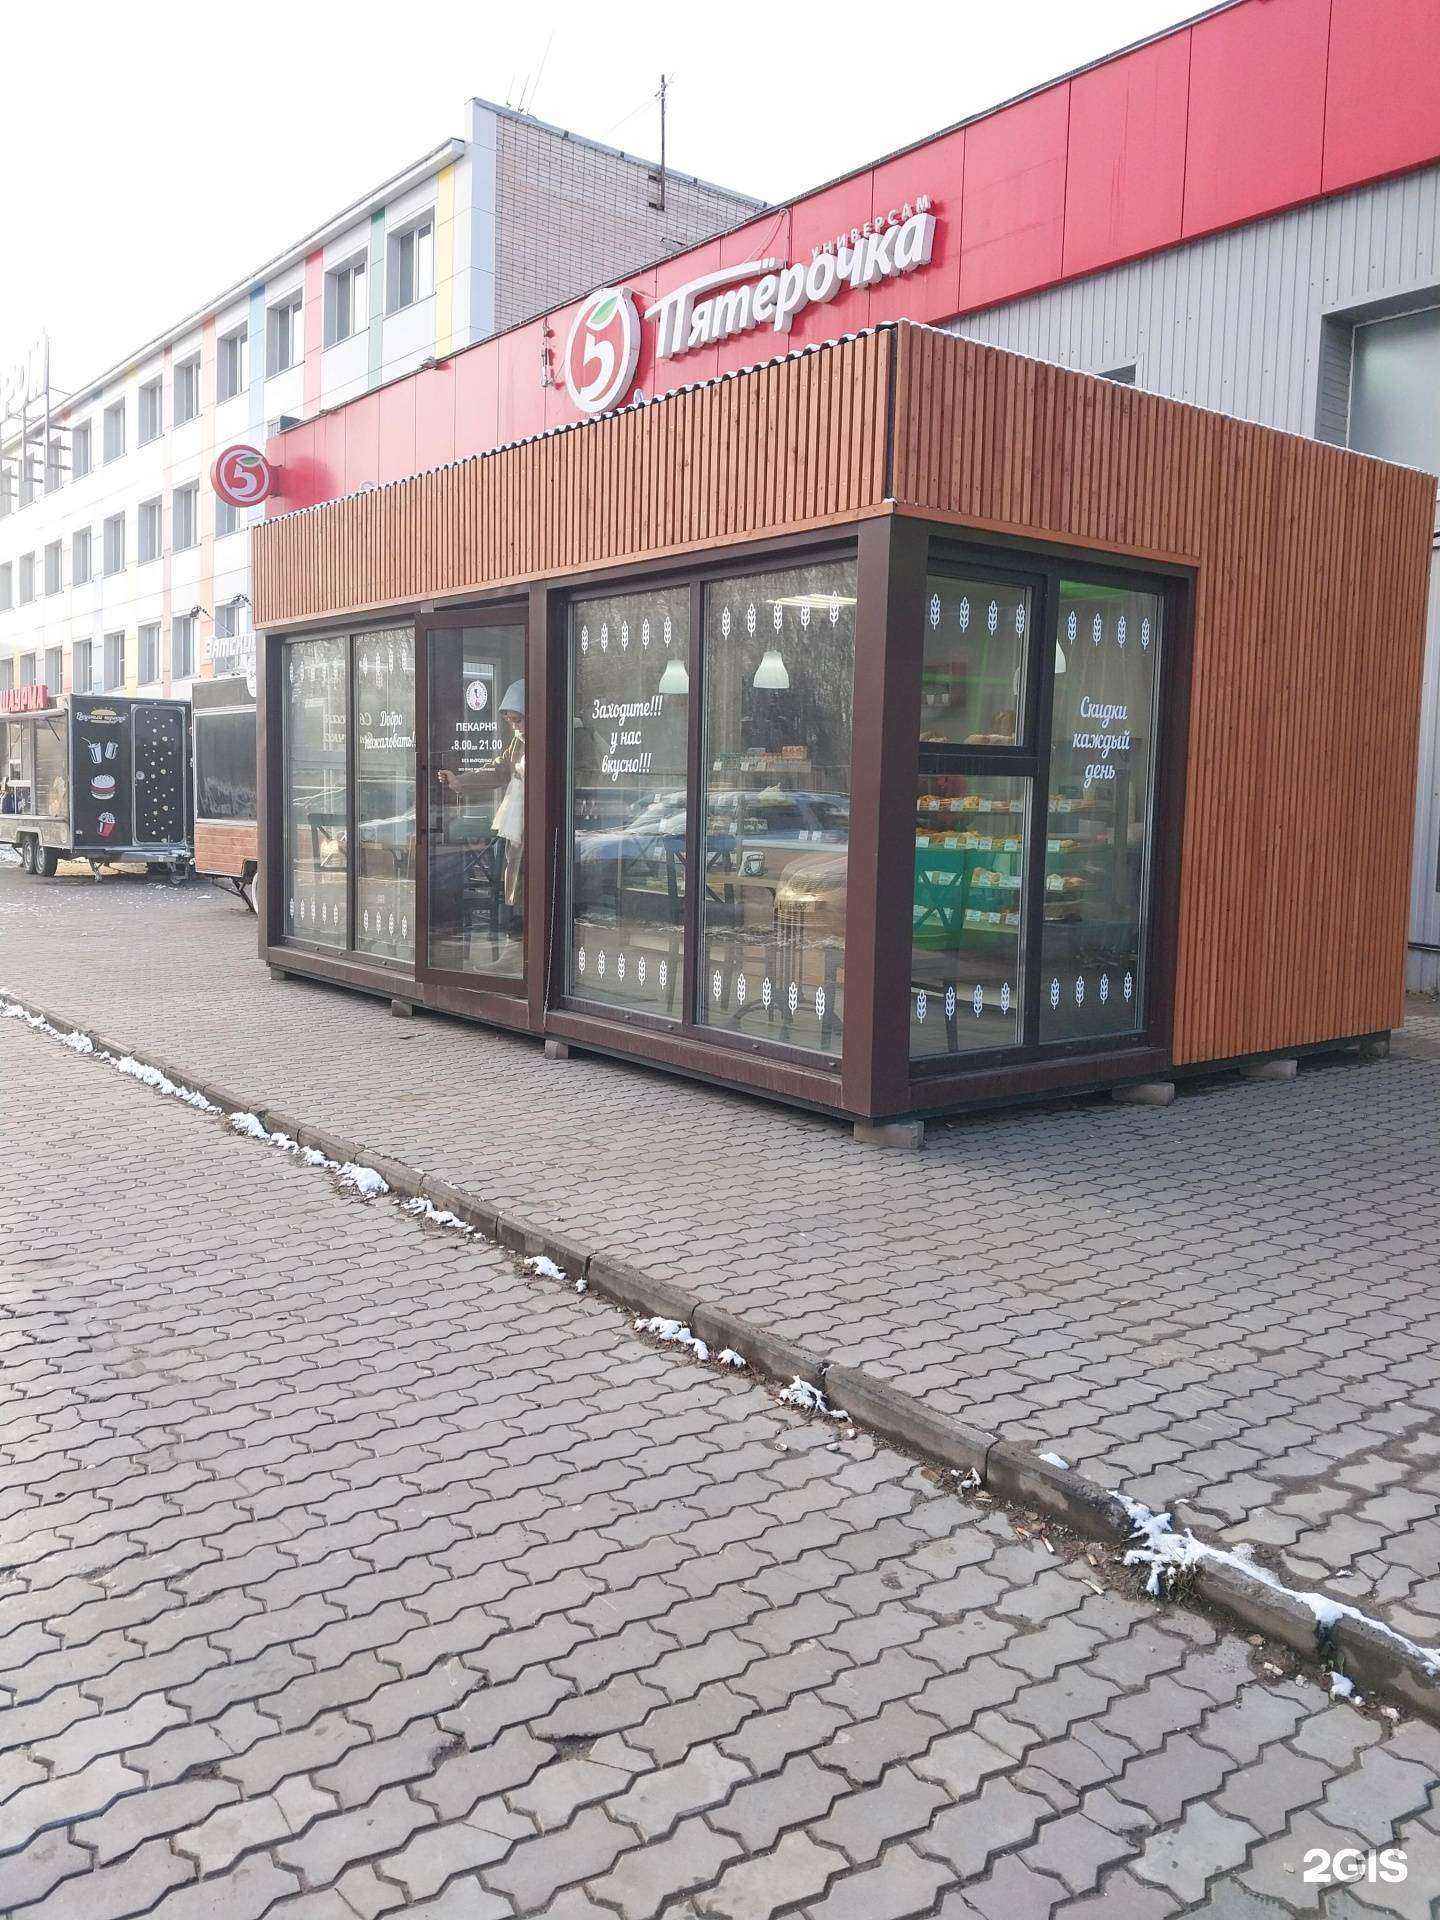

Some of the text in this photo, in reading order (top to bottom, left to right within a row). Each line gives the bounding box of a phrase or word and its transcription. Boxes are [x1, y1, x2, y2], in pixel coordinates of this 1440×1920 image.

[811, 194, 932, 260] УНИВЕРСАМ
[644, 213, 936, 359] Пятёрочка
[380, 711, 403, 732] Добро
[592, 695, 663, 727] Заходите!!!
[1080, 695, 1128, 729] Скидки
[456, 722, 498, 732] ПЕКАРНЯ
[454, 740, 472, 750] 8.00
[479, 739, 503, 750] 21.00
[609, 731, 642, 755] у нас
[1072, 730, 1131, 759] каждый
[601, 752, 652, 782] вкусно!!!
[1083, 763, 1115, 789] день
